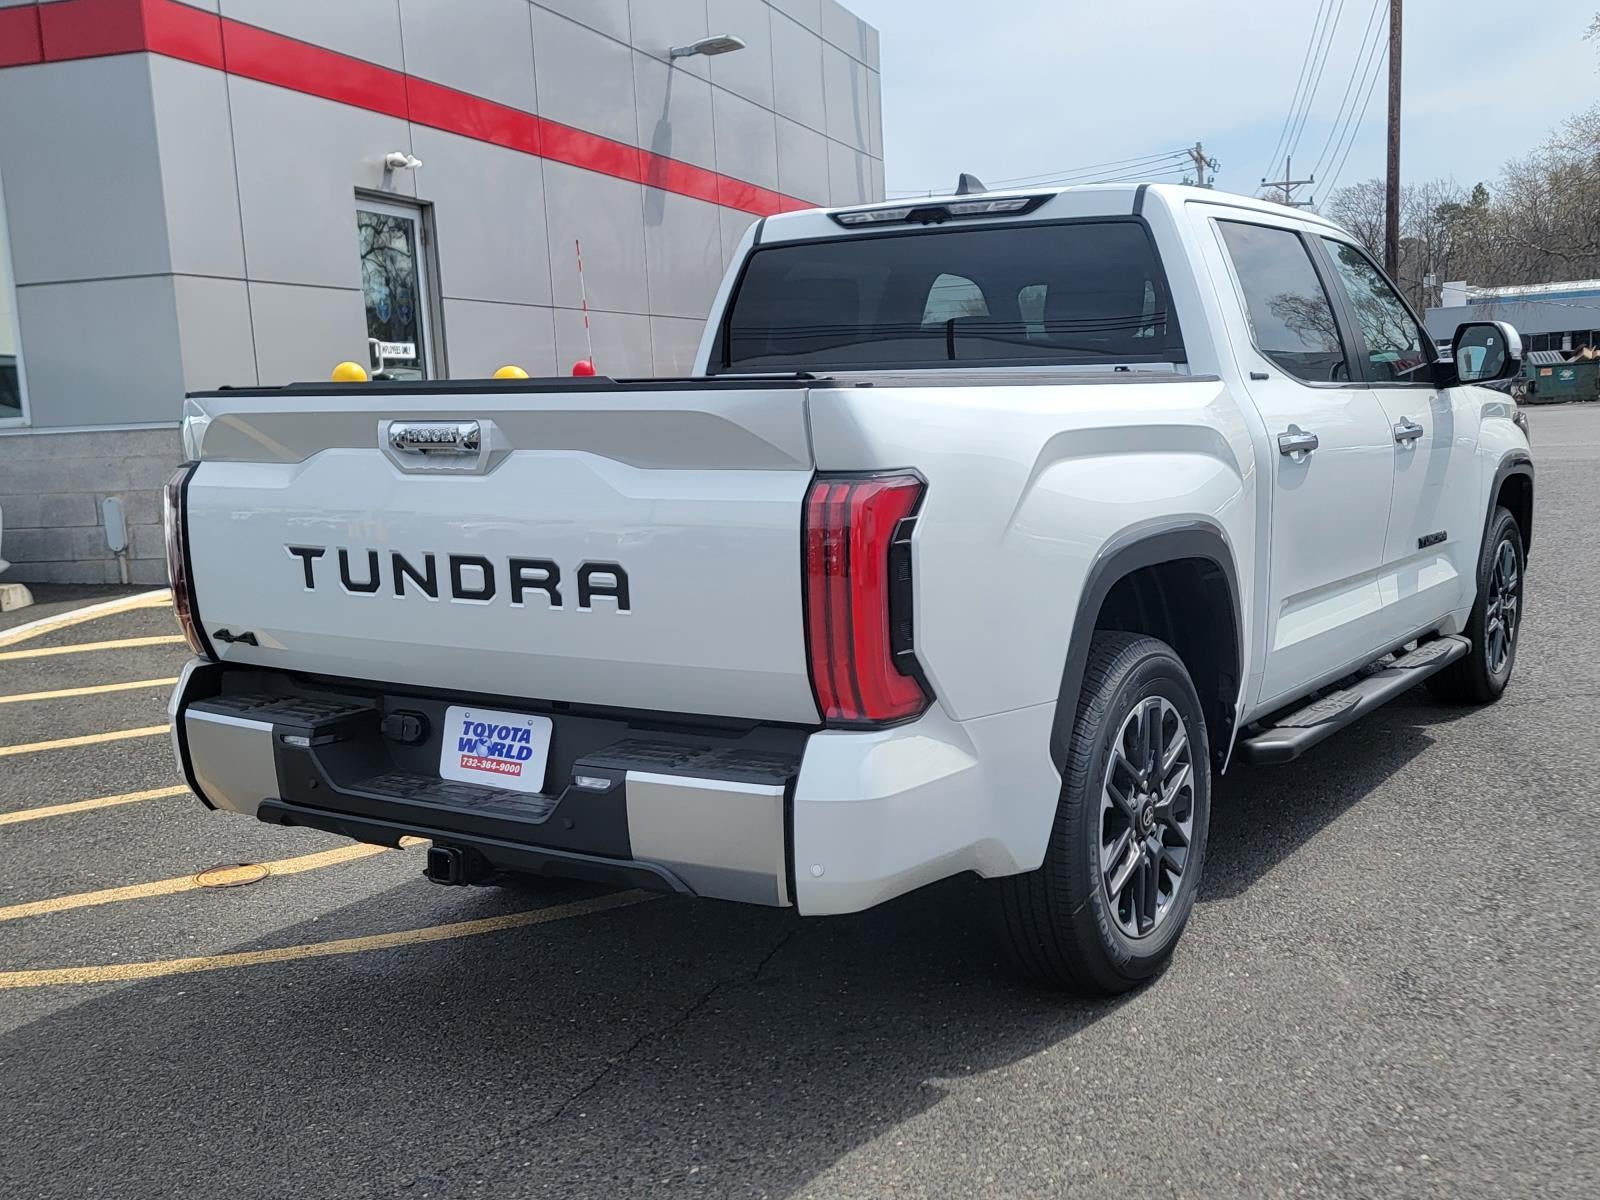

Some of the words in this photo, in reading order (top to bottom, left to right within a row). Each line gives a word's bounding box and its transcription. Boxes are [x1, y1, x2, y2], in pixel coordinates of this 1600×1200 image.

[382, 344, 401, 355] MPLOYEES
[407, 427, 456, 443] TOYOTA
[284, 543, 632, 615] TUNDRA
[463, 720, 531, 744] TOYOTA
[458, 737, 533, 761] WORLD
[462, 757, 521, 773] 732-364-9000
